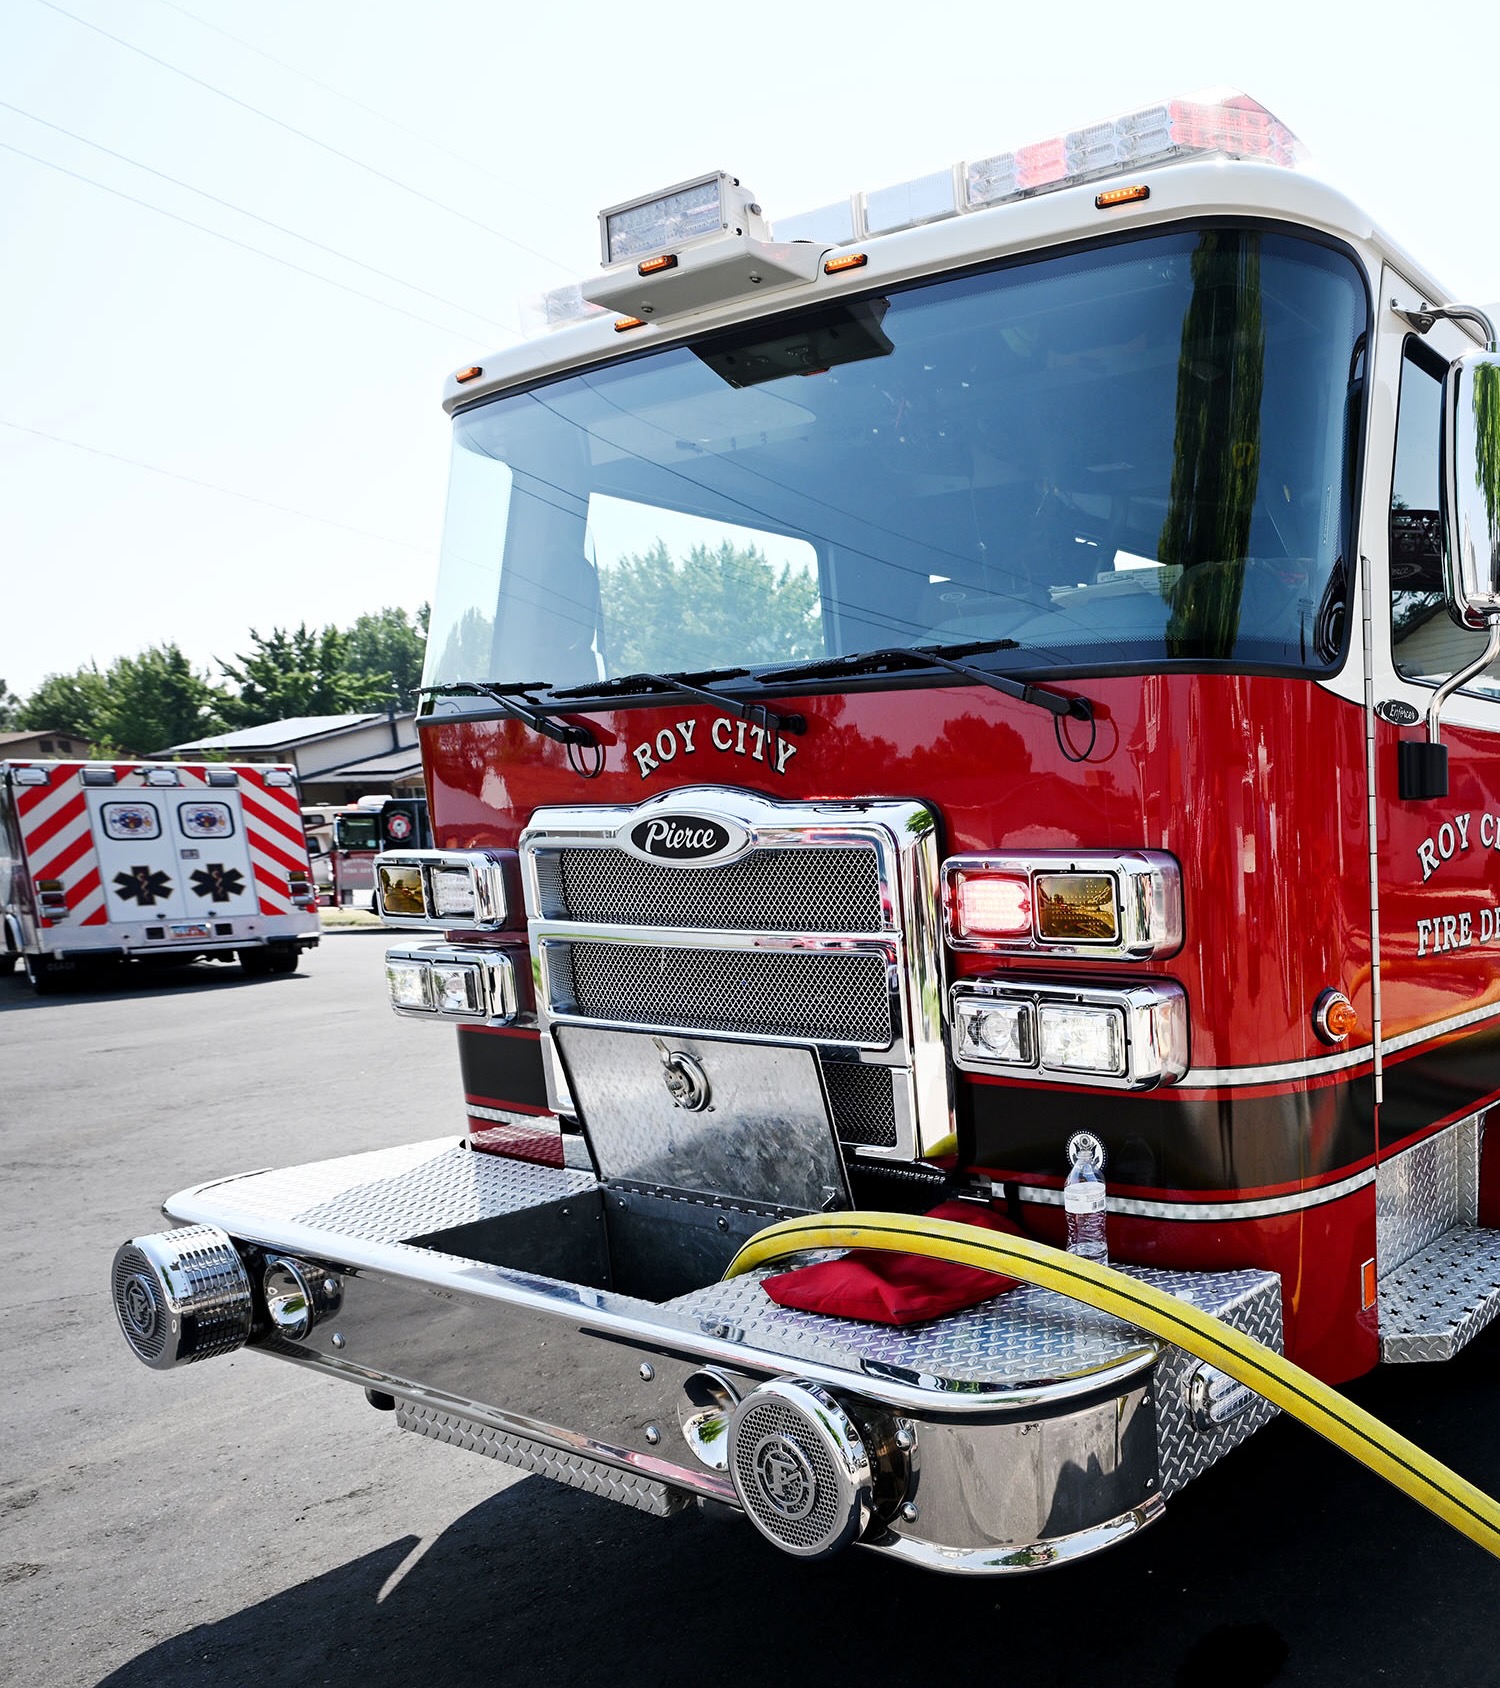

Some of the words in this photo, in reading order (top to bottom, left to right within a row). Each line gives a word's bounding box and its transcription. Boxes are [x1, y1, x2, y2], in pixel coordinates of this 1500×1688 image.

[633, 719, 696, 778] ROY
[712, 717, 797, 774] CITY
[644, 819, 717, 853] Pierce
[1417, 813, 1471, 883] ROY
[1417, 912, 1473, 958] FIRE
